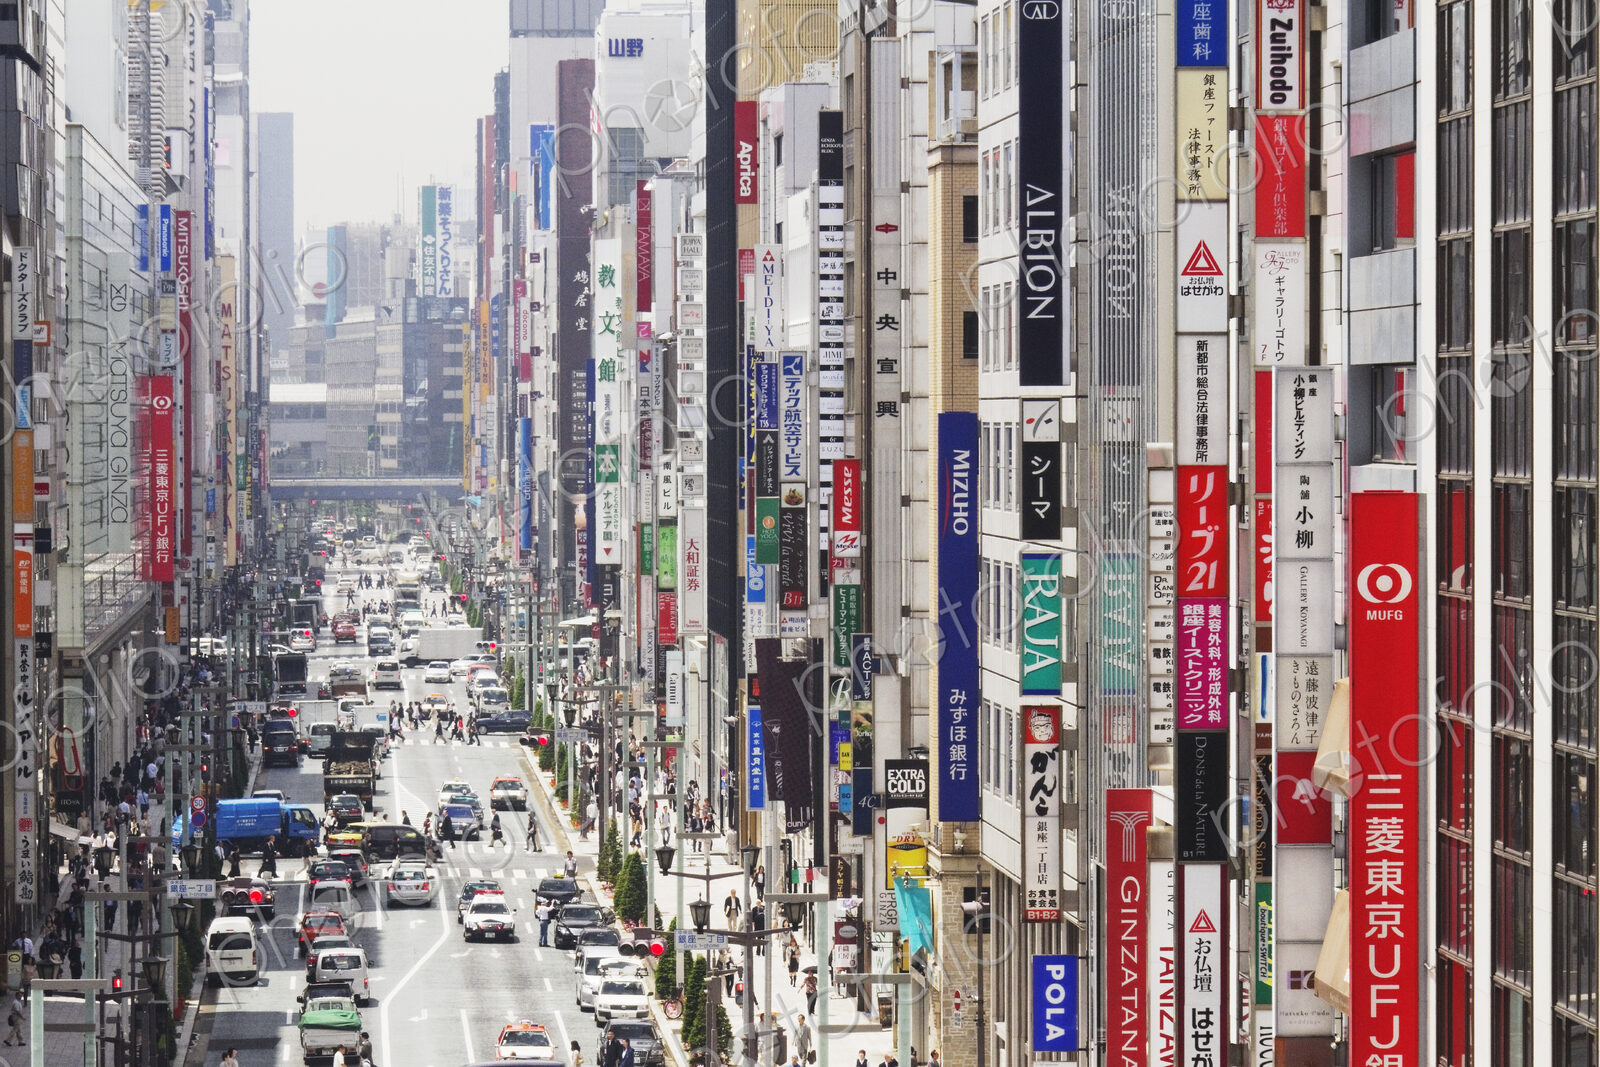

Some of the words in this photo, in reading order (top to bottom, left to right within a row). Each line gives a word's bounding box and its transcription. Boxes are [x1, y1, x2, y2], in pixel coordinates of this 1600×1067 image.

[608, 38, 643, 57] 山野
[1192, 0, 1212, 61] 座歯科
[1269, 17, 1293, 105] Zuihodo
[1203, 73, 1217, 169] 銀座ファースト
[737, 140, 755, 197] Aprica
[1188, 127, 1201, 196] 法律事務所
[178, 217, 189, 312] MITSUKOSHI
[438, 187, 452, 295] 新築そっくりさん
[637, 226, 650, 282] TAMAYA
[1026, 183, 1056, 319] ALBION
[17, 252, 28, 333] ドクターズクラブ
[1180, 285, 1224, 296] はせがわ
[1188, 277, 1215, 285] お仏壇
[598, 263, 616, 383] 教文館
[875, 267, 899, 418] 中央宣興
[1275, 275, 1285, 362] ギャラリーゴトウ
[1195, 339, 1208, 462] 新都市総合法律事務所
[1293, 374, 1306, 459] 小柳ビルディング
[1308, 374, 1317, 397] 銀座
[784, 377, 802, 477] テック航空サービス
[156, 449, 169, 563] 三菱東京UFJ銀行
[603, 490, 613, 541] ナルニア国
[662, 462, 672, 511] 南風ビル
[842, 466, 853, 524] Messe
[953, 449, 970, 536] MIZUHO
[1031, 456, 1051, 519] シーマ
[1186, 471, 1219, 592] リーブ21
[1295, 505, 1314, 550] 小柳
[685, 538, 700, 591] 大和証券
[1300, 566, 1308, 604] GALLERY
[1023, 571, 1059, 677] RAJA
[1300, 606, 1308, 648] KOYANAGI
[1366, 610, 1403, 620] MUFG
[669, 673, 678, 705] Camui
[863, 652, 871, 679] ACT
[1182, 604, 1205, 724] 銀座イーストクリニック
[1208, 604, 1221, 723] 美容外科・形成外科
[1304, 659, 1319, 744] 遠藤波津子
[949, 688, 968, 781] みずほ銀行
[1195, 736, 1207, 776] DONS
[194, 799, 203, 807] 50
[887, 769, 925, 780] EXTRA
[887, 780, 926, 793] COLD
[1030, 746, 1058, 817] がんこ
[1036, 820, 1048, 886] 銀座一丁目店
[887, 892, 897, 926] PRGR
[1028, 889, 1057, 899] お食事
[678, 934, 725, 943] 銀座一丁目
[1193, 938, 1212, 993] お仏壇
[1045, 964, 1066, 1042] POLA
